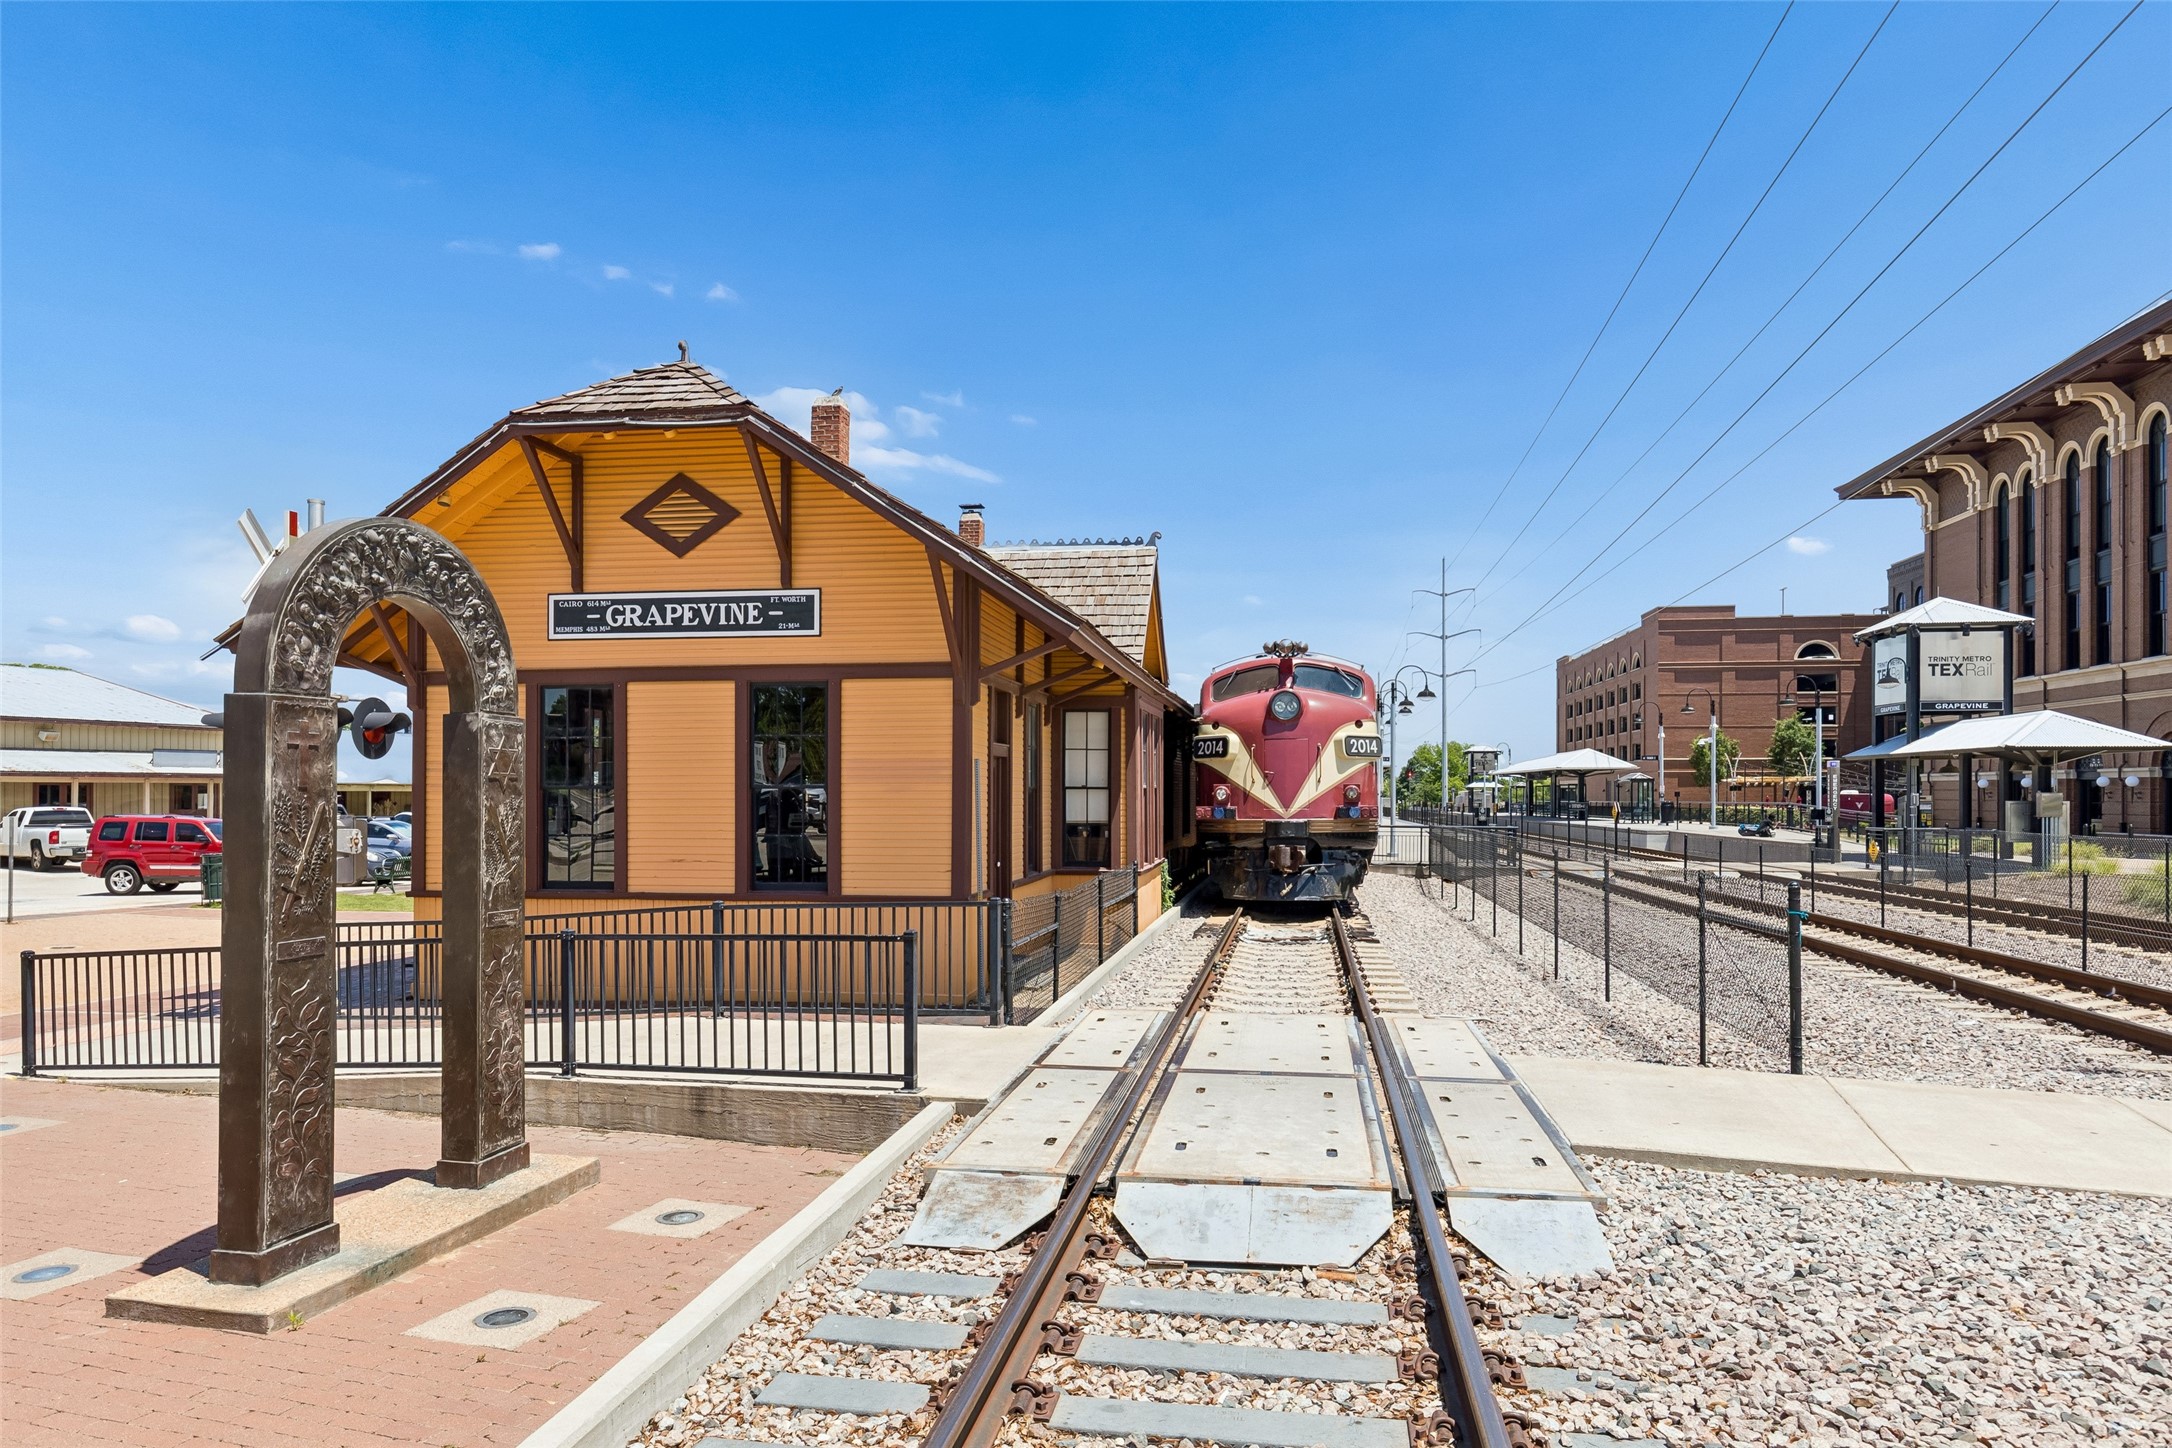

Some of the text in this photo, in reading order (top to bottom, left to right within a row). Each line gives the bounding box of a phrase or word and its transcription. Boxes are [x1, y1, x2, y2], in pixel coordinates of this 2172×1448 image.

[605, 602, 764, 627] GRAPEVINE
[1198, 740, 1223, 755] 2014
[1350, 739, 1378, 754] 2014
